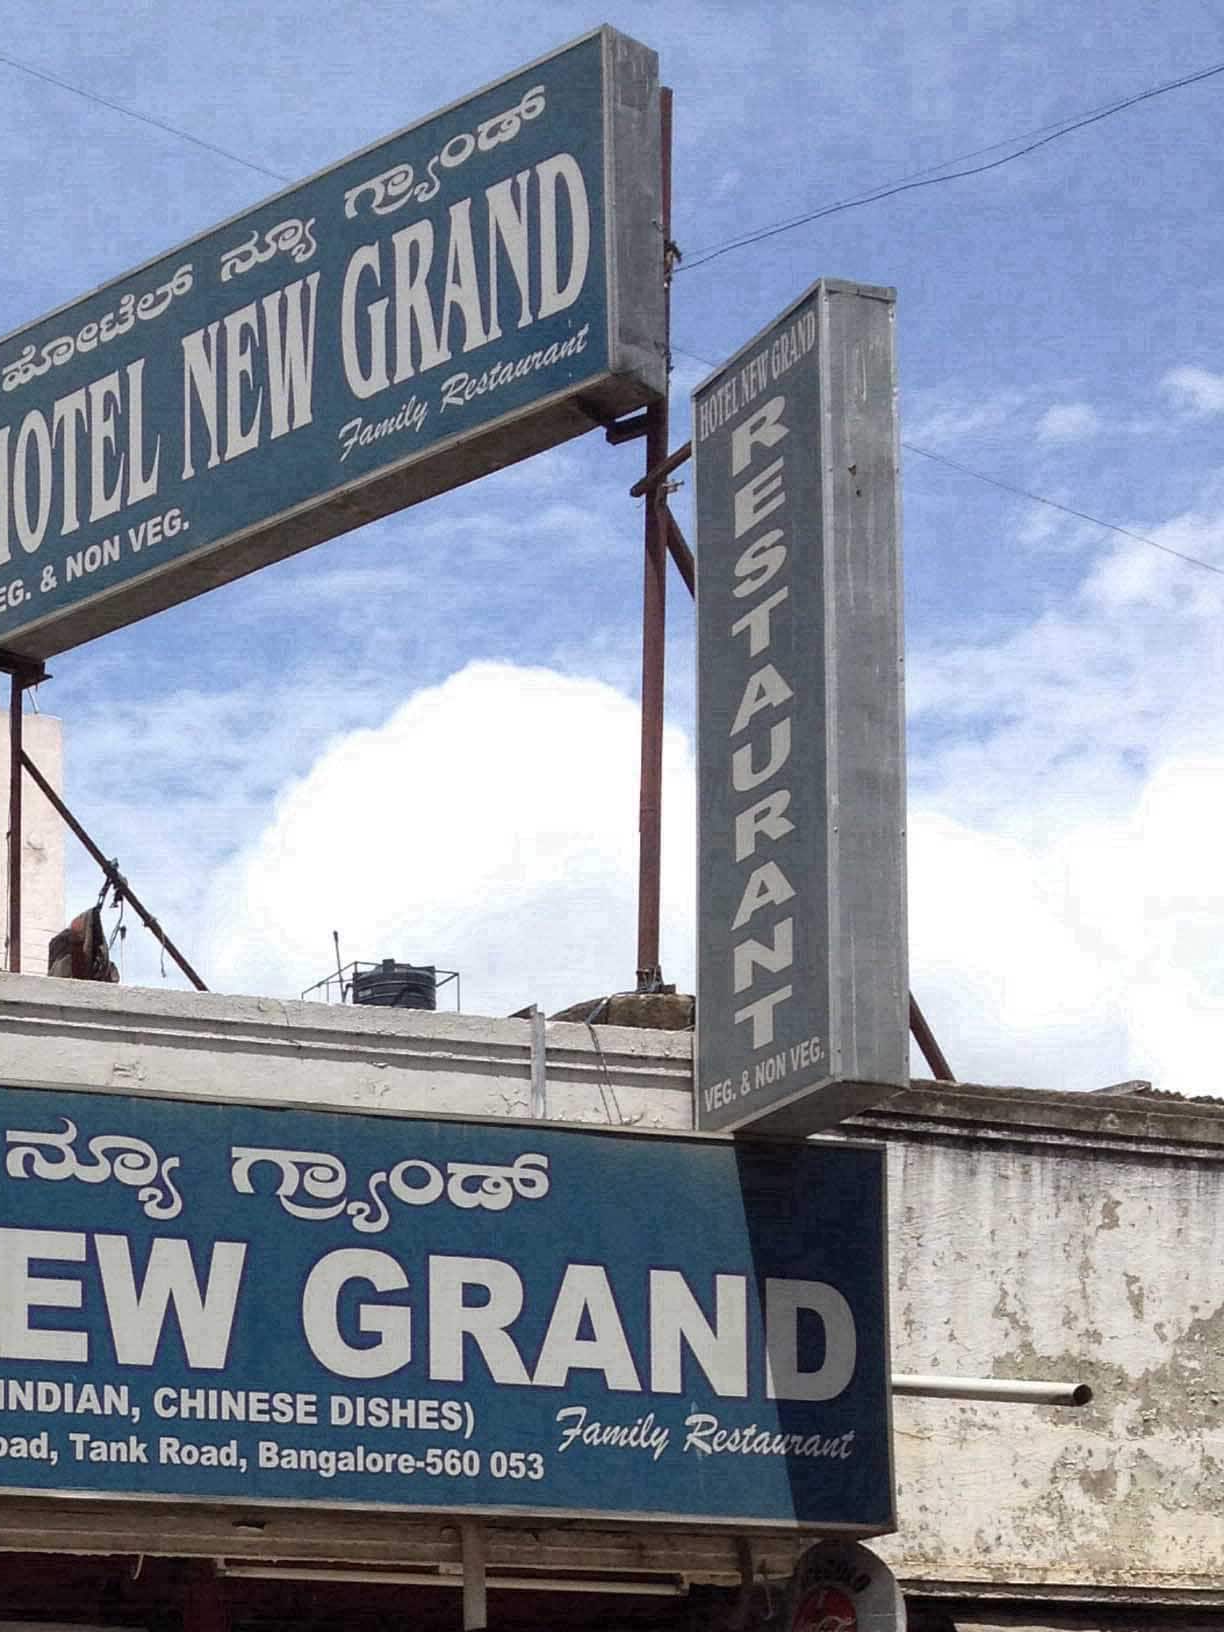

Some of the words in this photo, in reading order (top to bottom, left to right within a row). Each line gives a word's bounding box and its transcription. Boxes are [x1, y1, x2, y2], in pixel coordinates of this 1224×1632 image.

[181, 271, 321, 482] NEW
[340, 152, 591, 399] GRAND
[338, 400, 429, 463] Family
[440, 323, 589, 408] Restaurant
[700, 378, 739, 442] HOTEL
[741, 350, 769, 407] NEW
[771, 310, 816, 380] GRAND
[40, 565, 58, 595] &
[65, 536, 121, 582] NON
[128, 506, 190, 554] VEG.
[729, 395, 797, 1050] RESTAURANT
[704, 1077, 737, 1113] VEG.
[740, 1069, 751, 1097] &
[755, 1051, 787, 1089] NON
[790, 1036, 825, 1072] VEG.
[5, 1116, 183, 1221] ನ್ಯೂ
[302, 1247, 857, 1402] GRAND
[70, 1432, 148, 1464] Tank
[159, 1439, 248, 1475] Road,
[259, 1441, 480, 1479] Bangalore-560
[489, 1452, 545, 1481] 053
[153, 1386, 318, 1426] CHINESE
[330, 1395, 475, 1440] DISHES)
[556, 1405, 671, 1461] Family
[684, 1412, 855, 1461] Restaurant
